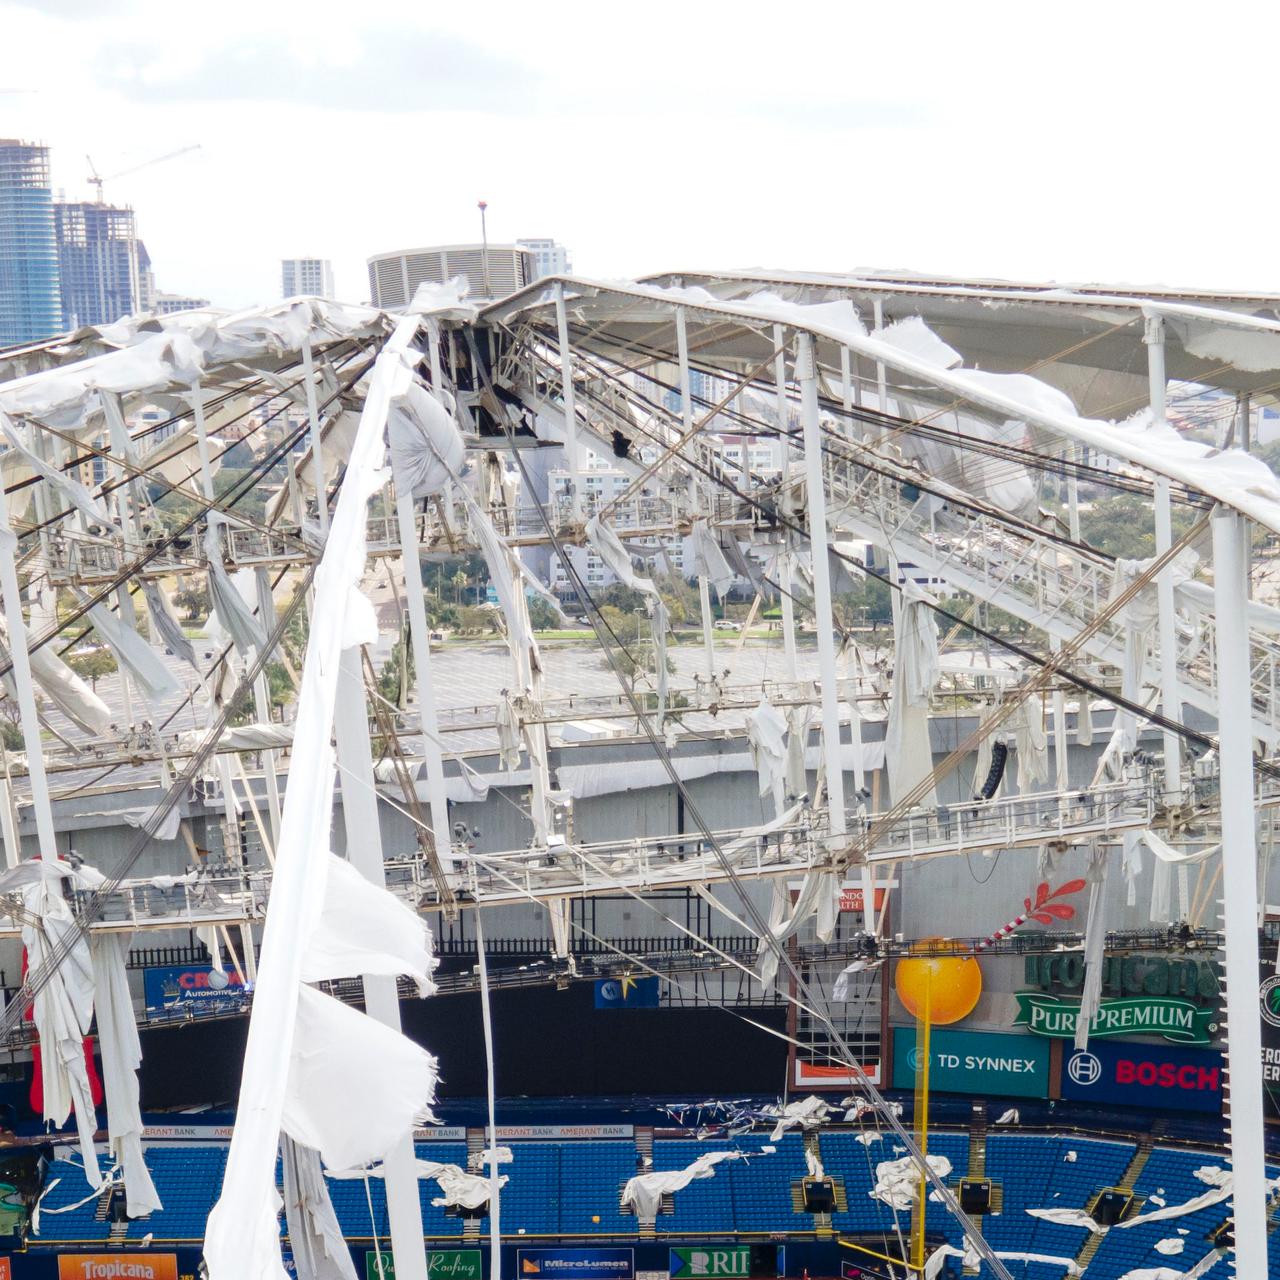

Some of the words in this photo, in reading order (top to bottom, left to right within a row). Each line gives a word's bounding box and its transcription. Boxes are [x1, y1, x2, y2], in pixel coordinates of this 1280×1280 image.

[1031, 1005, 1082, 1031] PUR
[1091, 1005, 1194, 1031] PREMIUM
[937, 1053, 960, 1069] TD
[964, 1054, 1036, 1074] SYNNEX
[1115, 1059, 1219, 1091] BOSCH
[142, 1128, 173, 1136] ERANT
[174, 1128, 196, 1136] BANK
[414, 1129, 437, 1137] RANT
[438, 1129, 460, 1137] BANK
[495, 1128, 532, 1137] MERANT
[532, 1127, 554, 1137] BANK
[559, 1127, 602, 1137] AMERANT
[602, 1126, 624, 1136] BANK
[81, 1260, 155, 1280] Tropicana
[428, 1255, 476, 1276] Roofing
[544, 1259, 629, 1267] MicroLumen
